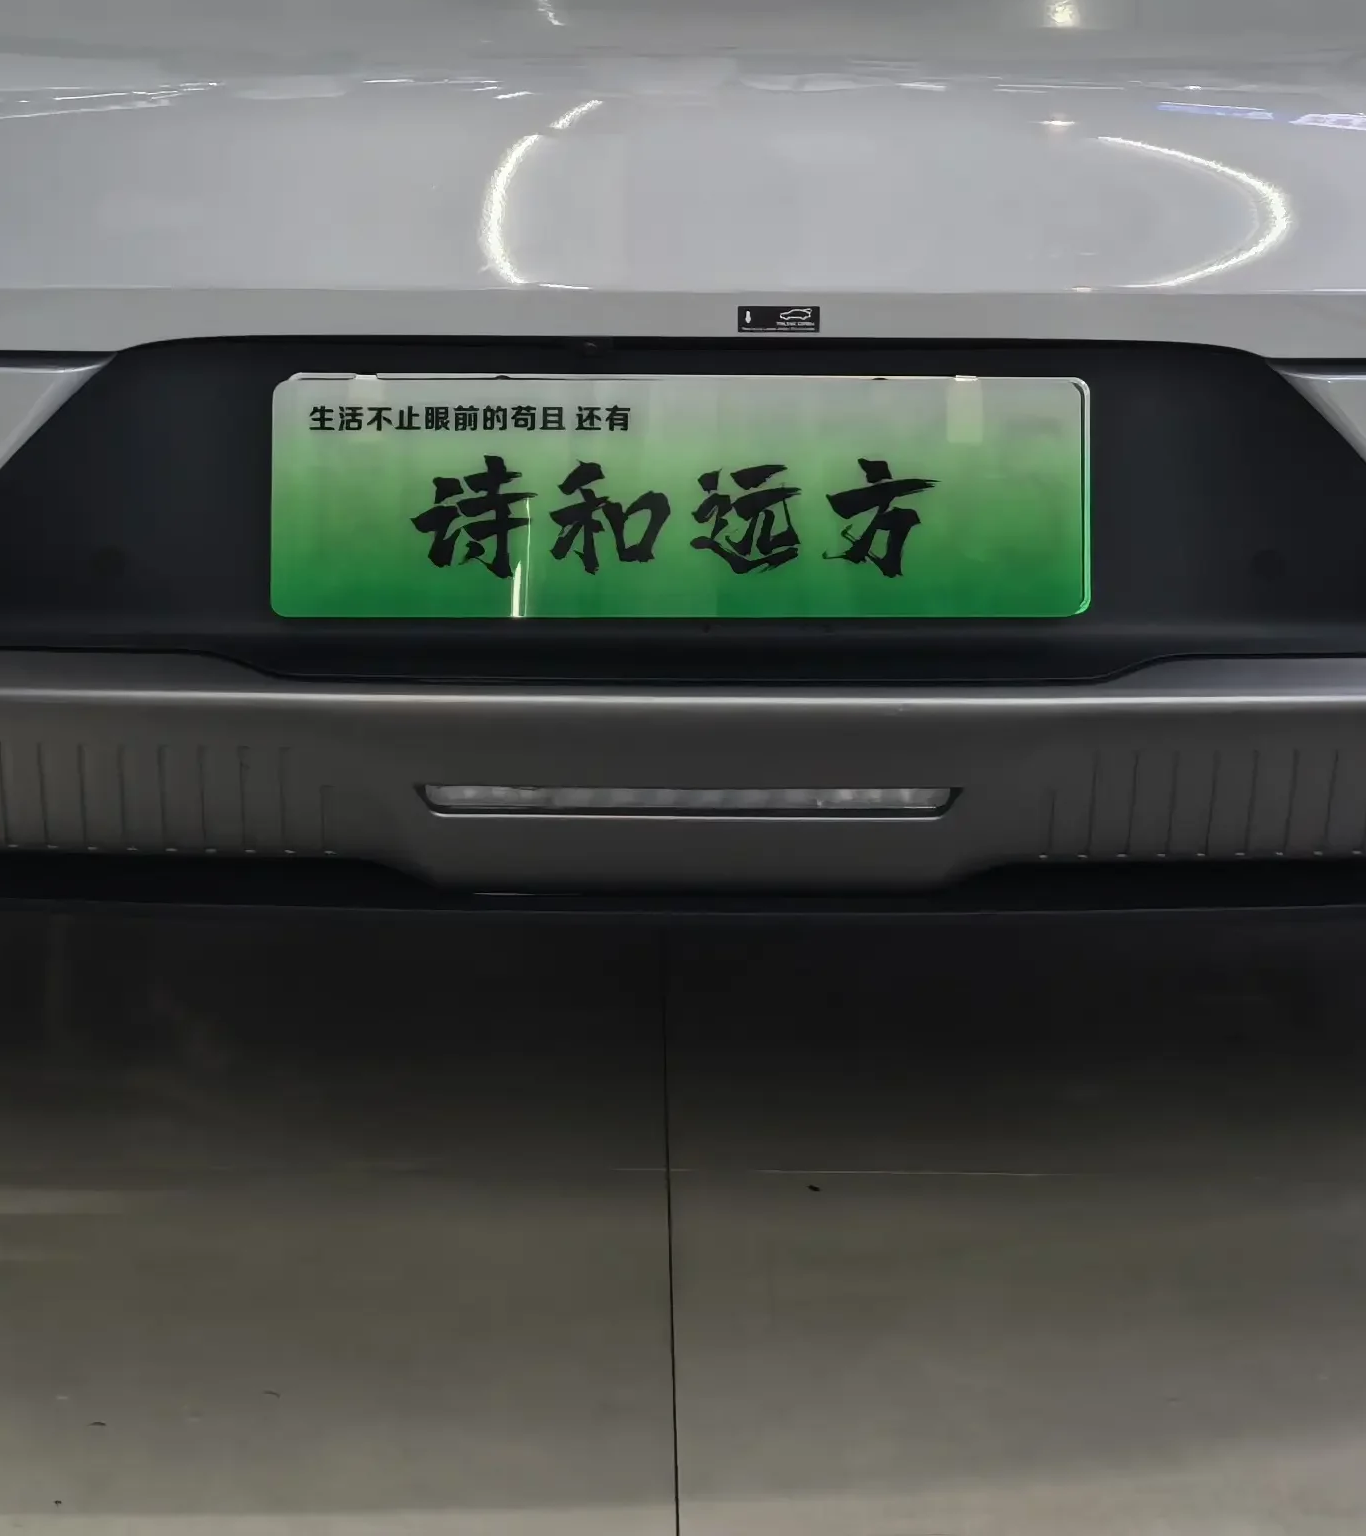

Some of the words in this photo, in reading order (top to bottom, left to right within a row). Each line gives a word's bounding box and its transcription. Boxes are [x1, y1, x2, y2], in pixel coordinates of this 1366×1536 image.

[308, 404, 567, 433] 生活不止眼前的苟且
[575, 405, 632, 433] 还有
[409, 454, 941, 579] 诗和远方
